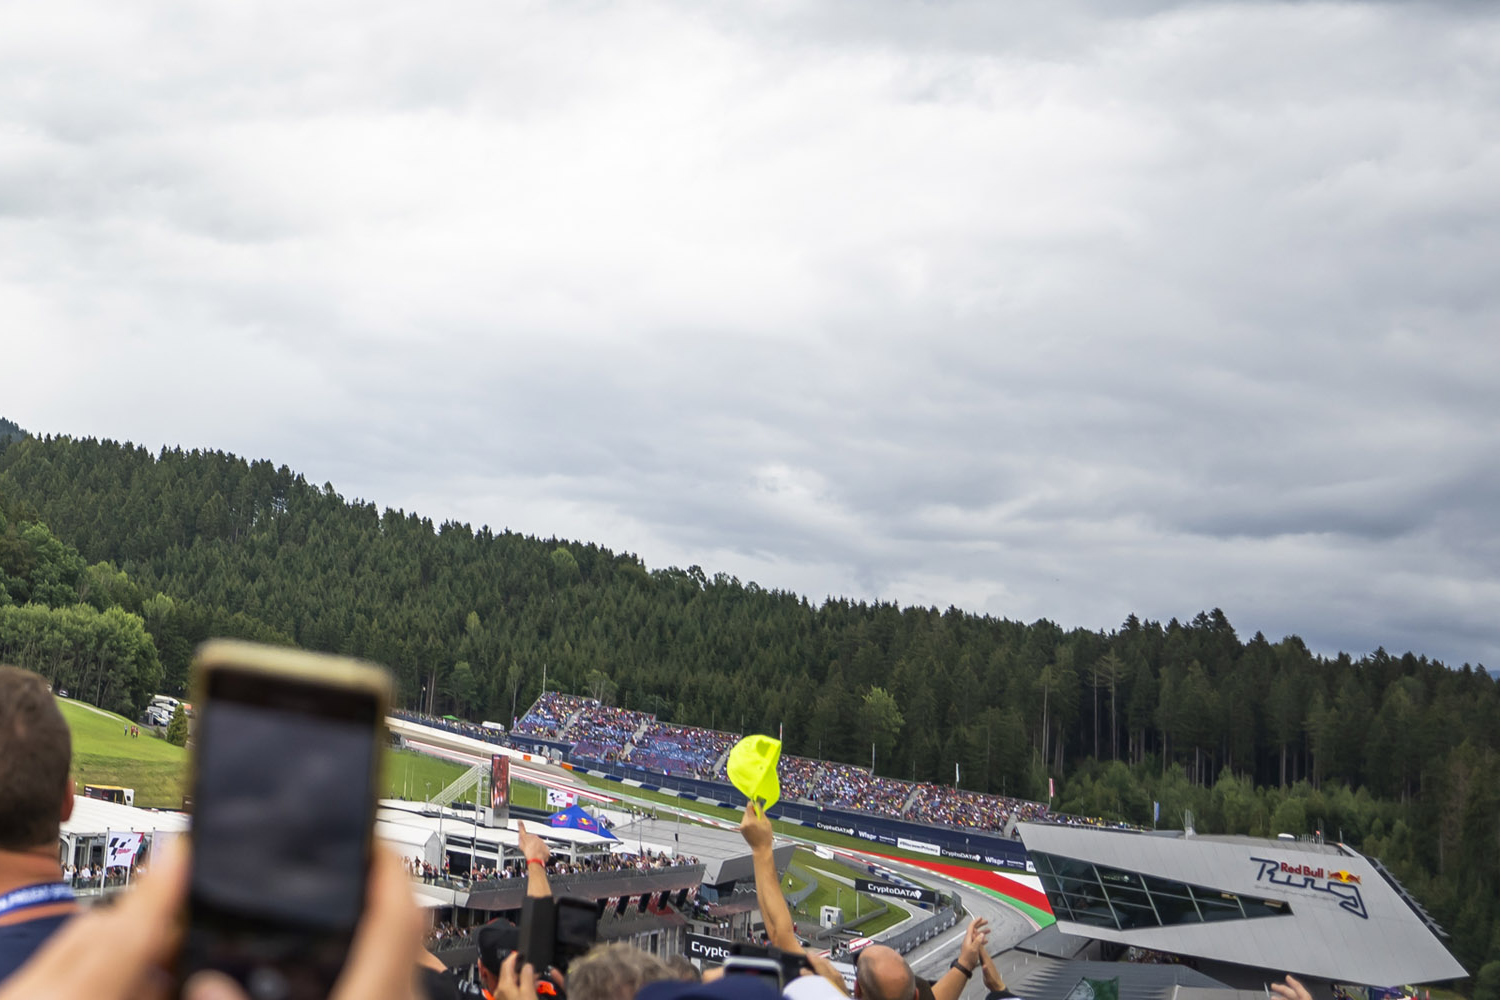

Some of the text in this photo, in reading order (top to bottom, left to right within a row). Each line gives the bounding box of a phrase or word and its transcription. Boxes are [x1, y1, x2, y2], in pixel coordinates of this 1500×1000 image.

[1280, 862, 1324, 878] Red Bull
[867, 883, 916, 898] CryptoDATA
